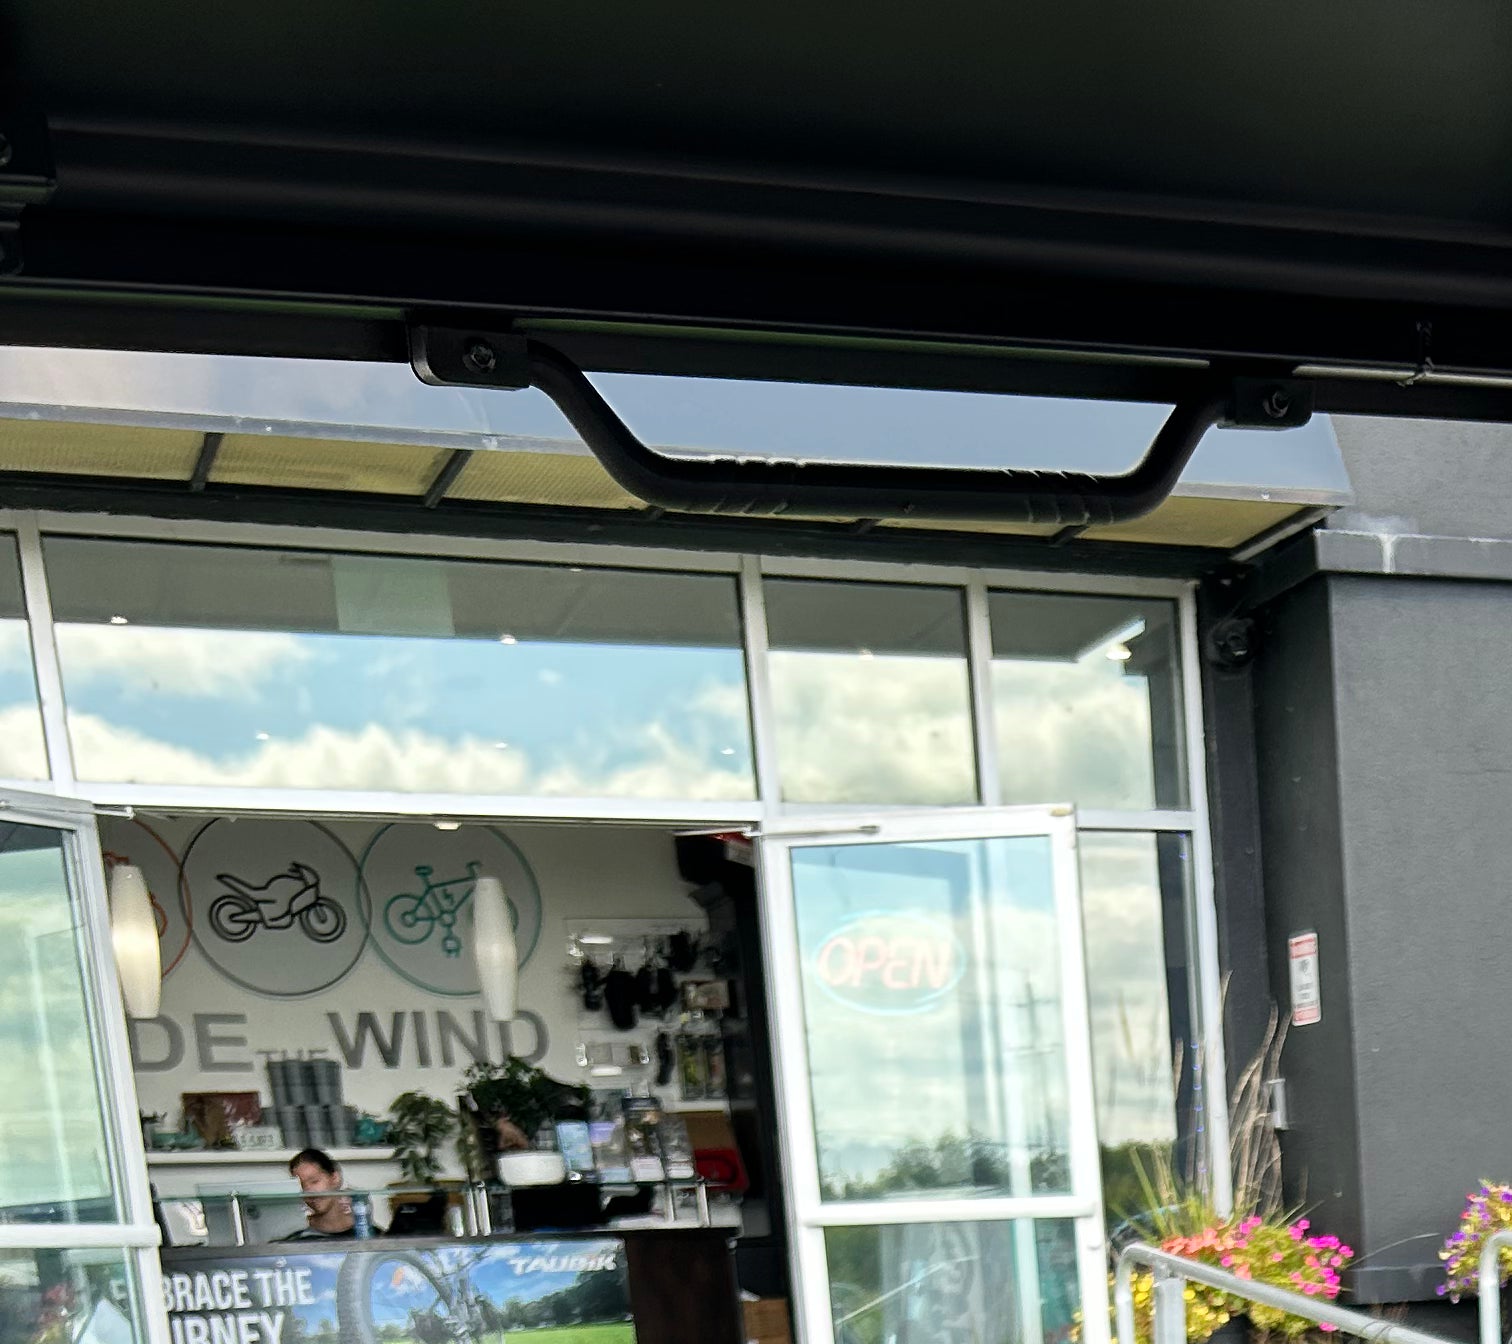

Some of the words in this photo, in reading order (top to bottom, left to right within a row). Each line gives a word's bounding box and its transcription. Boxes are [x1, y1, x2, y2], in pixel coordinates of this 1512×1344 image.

[816, 936, 951, 990] OPEN
[326, 1009, 551, 1071] WIND
[251, 1267, 316, 1309] THE
